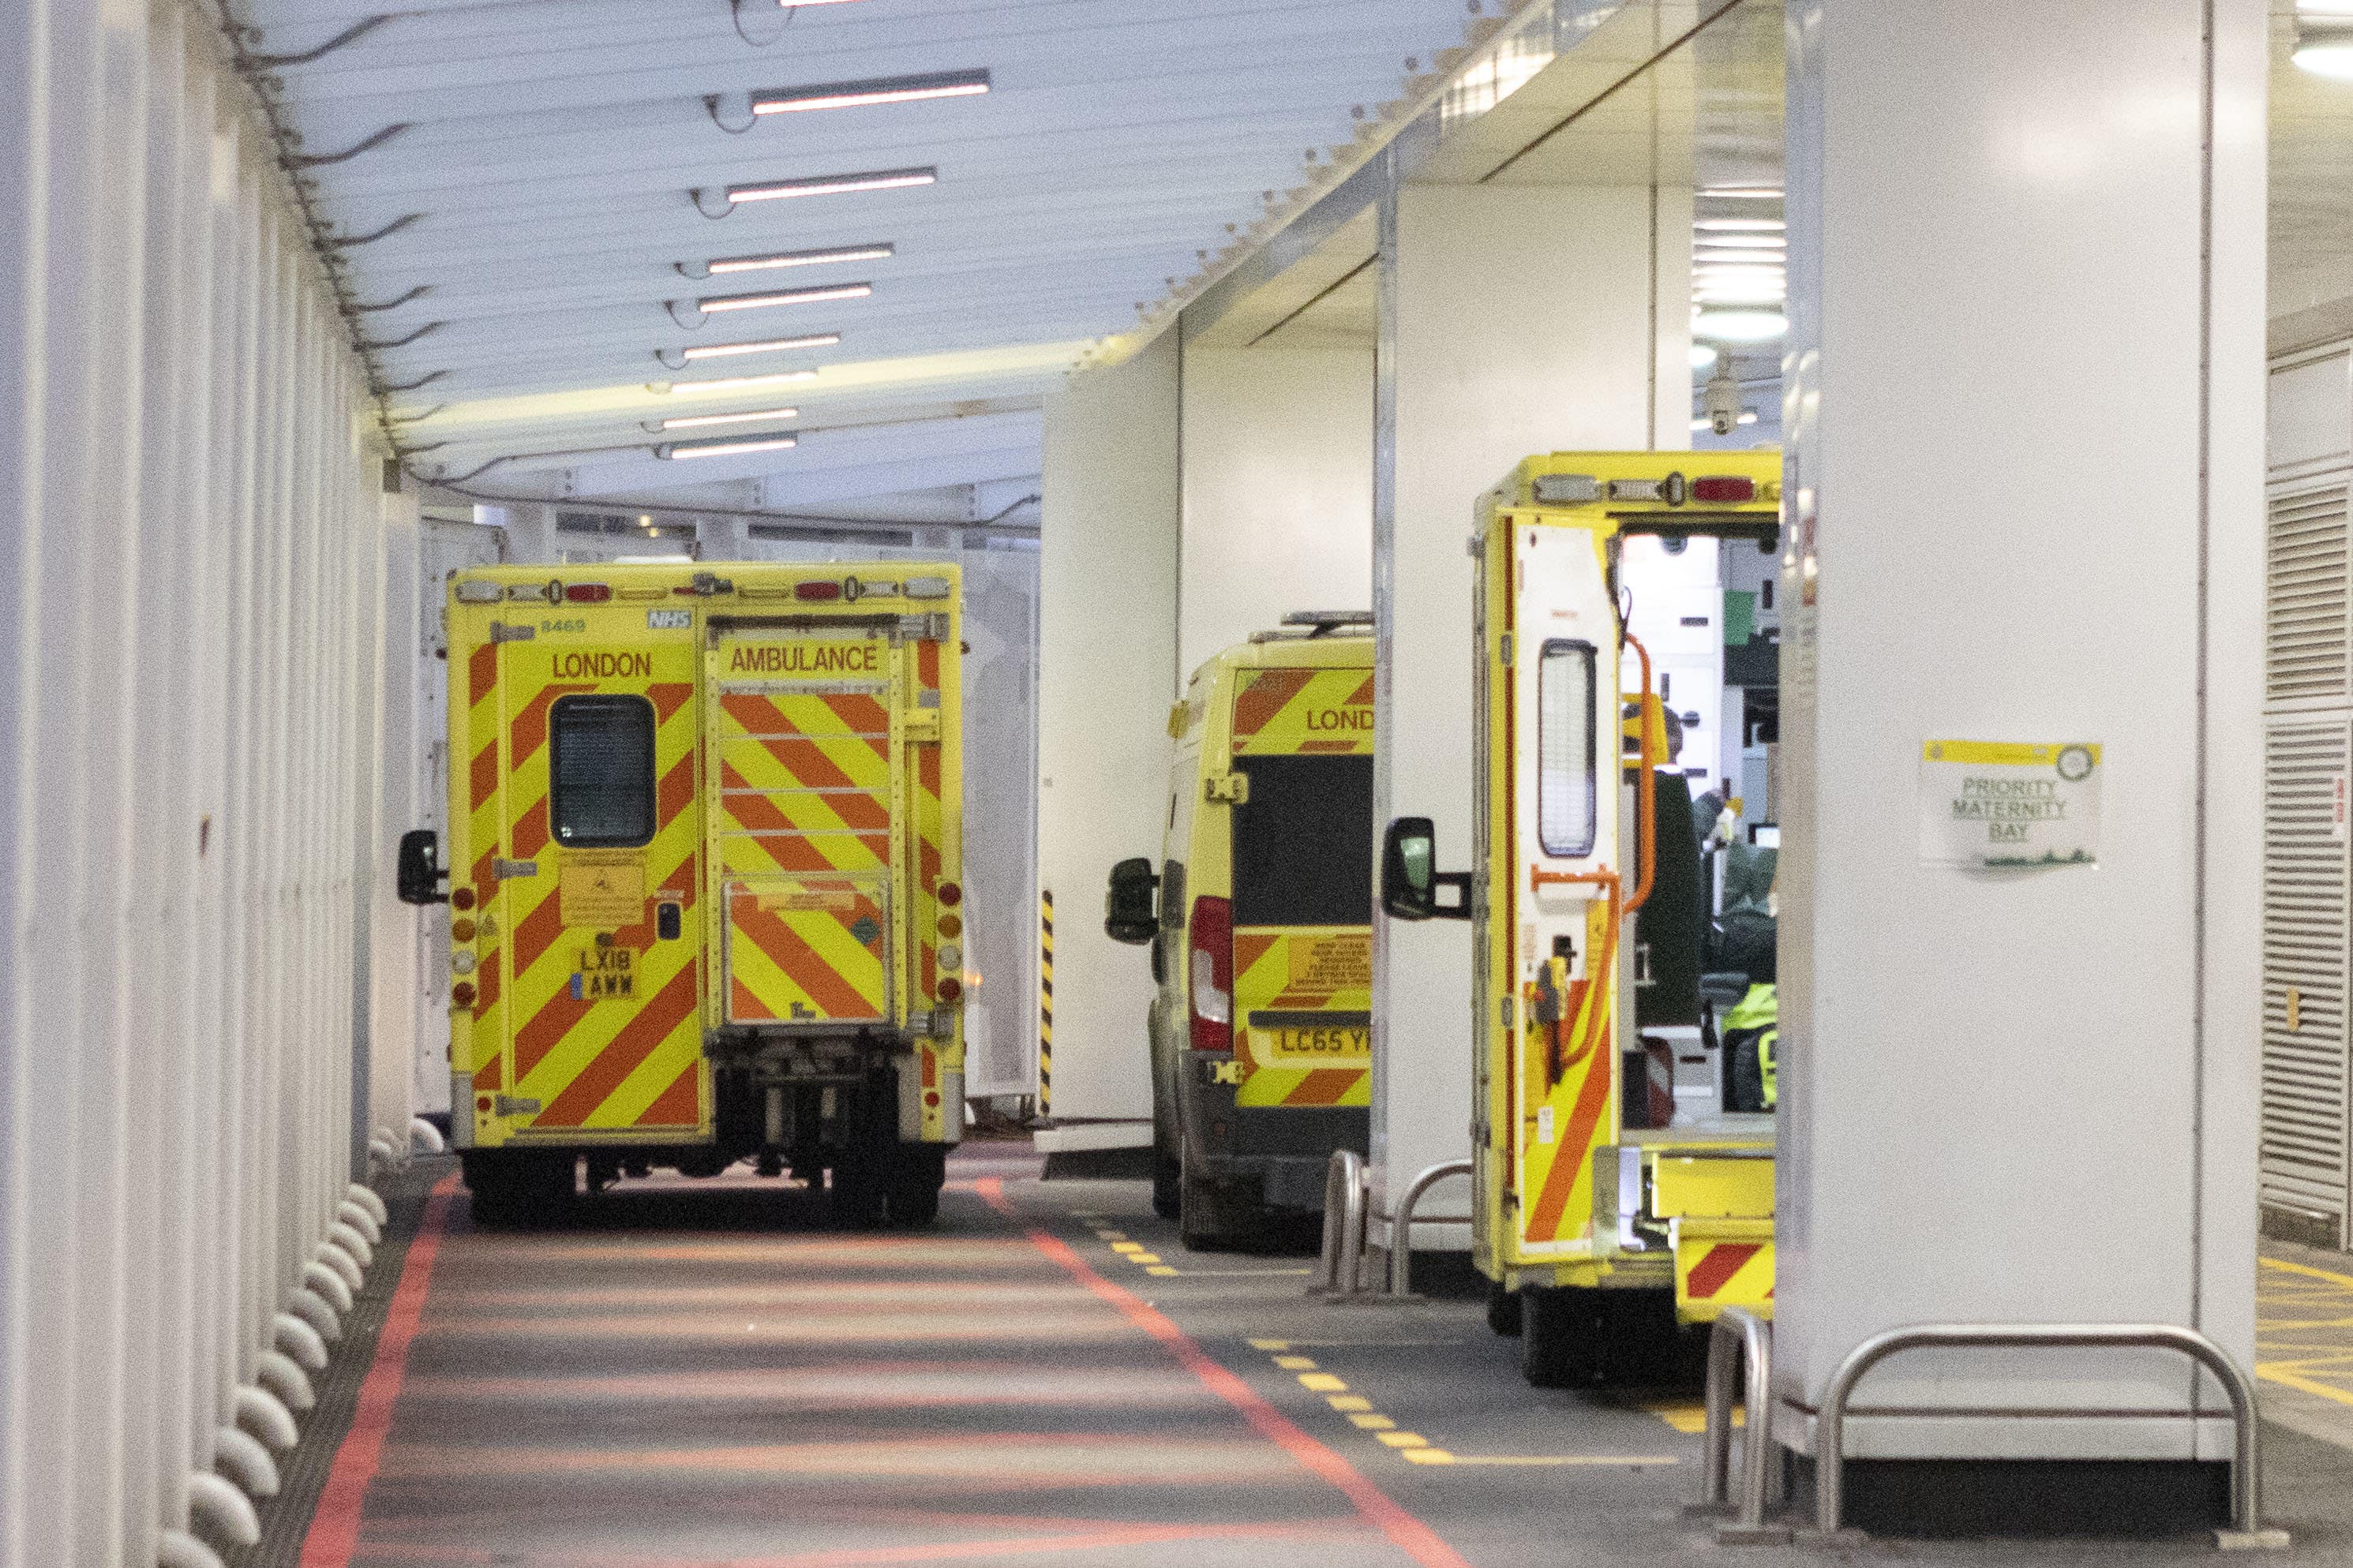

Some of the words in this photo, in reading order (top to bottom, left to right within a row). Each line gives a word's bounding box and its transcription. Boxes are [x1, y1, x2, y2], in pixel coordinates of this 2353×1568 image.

[648, 610, 691, 628] NHS
[553, 652, 651, 678] LONDON
[730, 646, 879, 672] AMBULANCE
[1963, 778, 2057, 796] PRIORITY
[1952, 799, 2066, 818] MATERNITY
[1988, 823, 2028, 840] BAY
[580, 950, 630, 971] LX18
[1280, 1028, 1343, 1052] LC65
